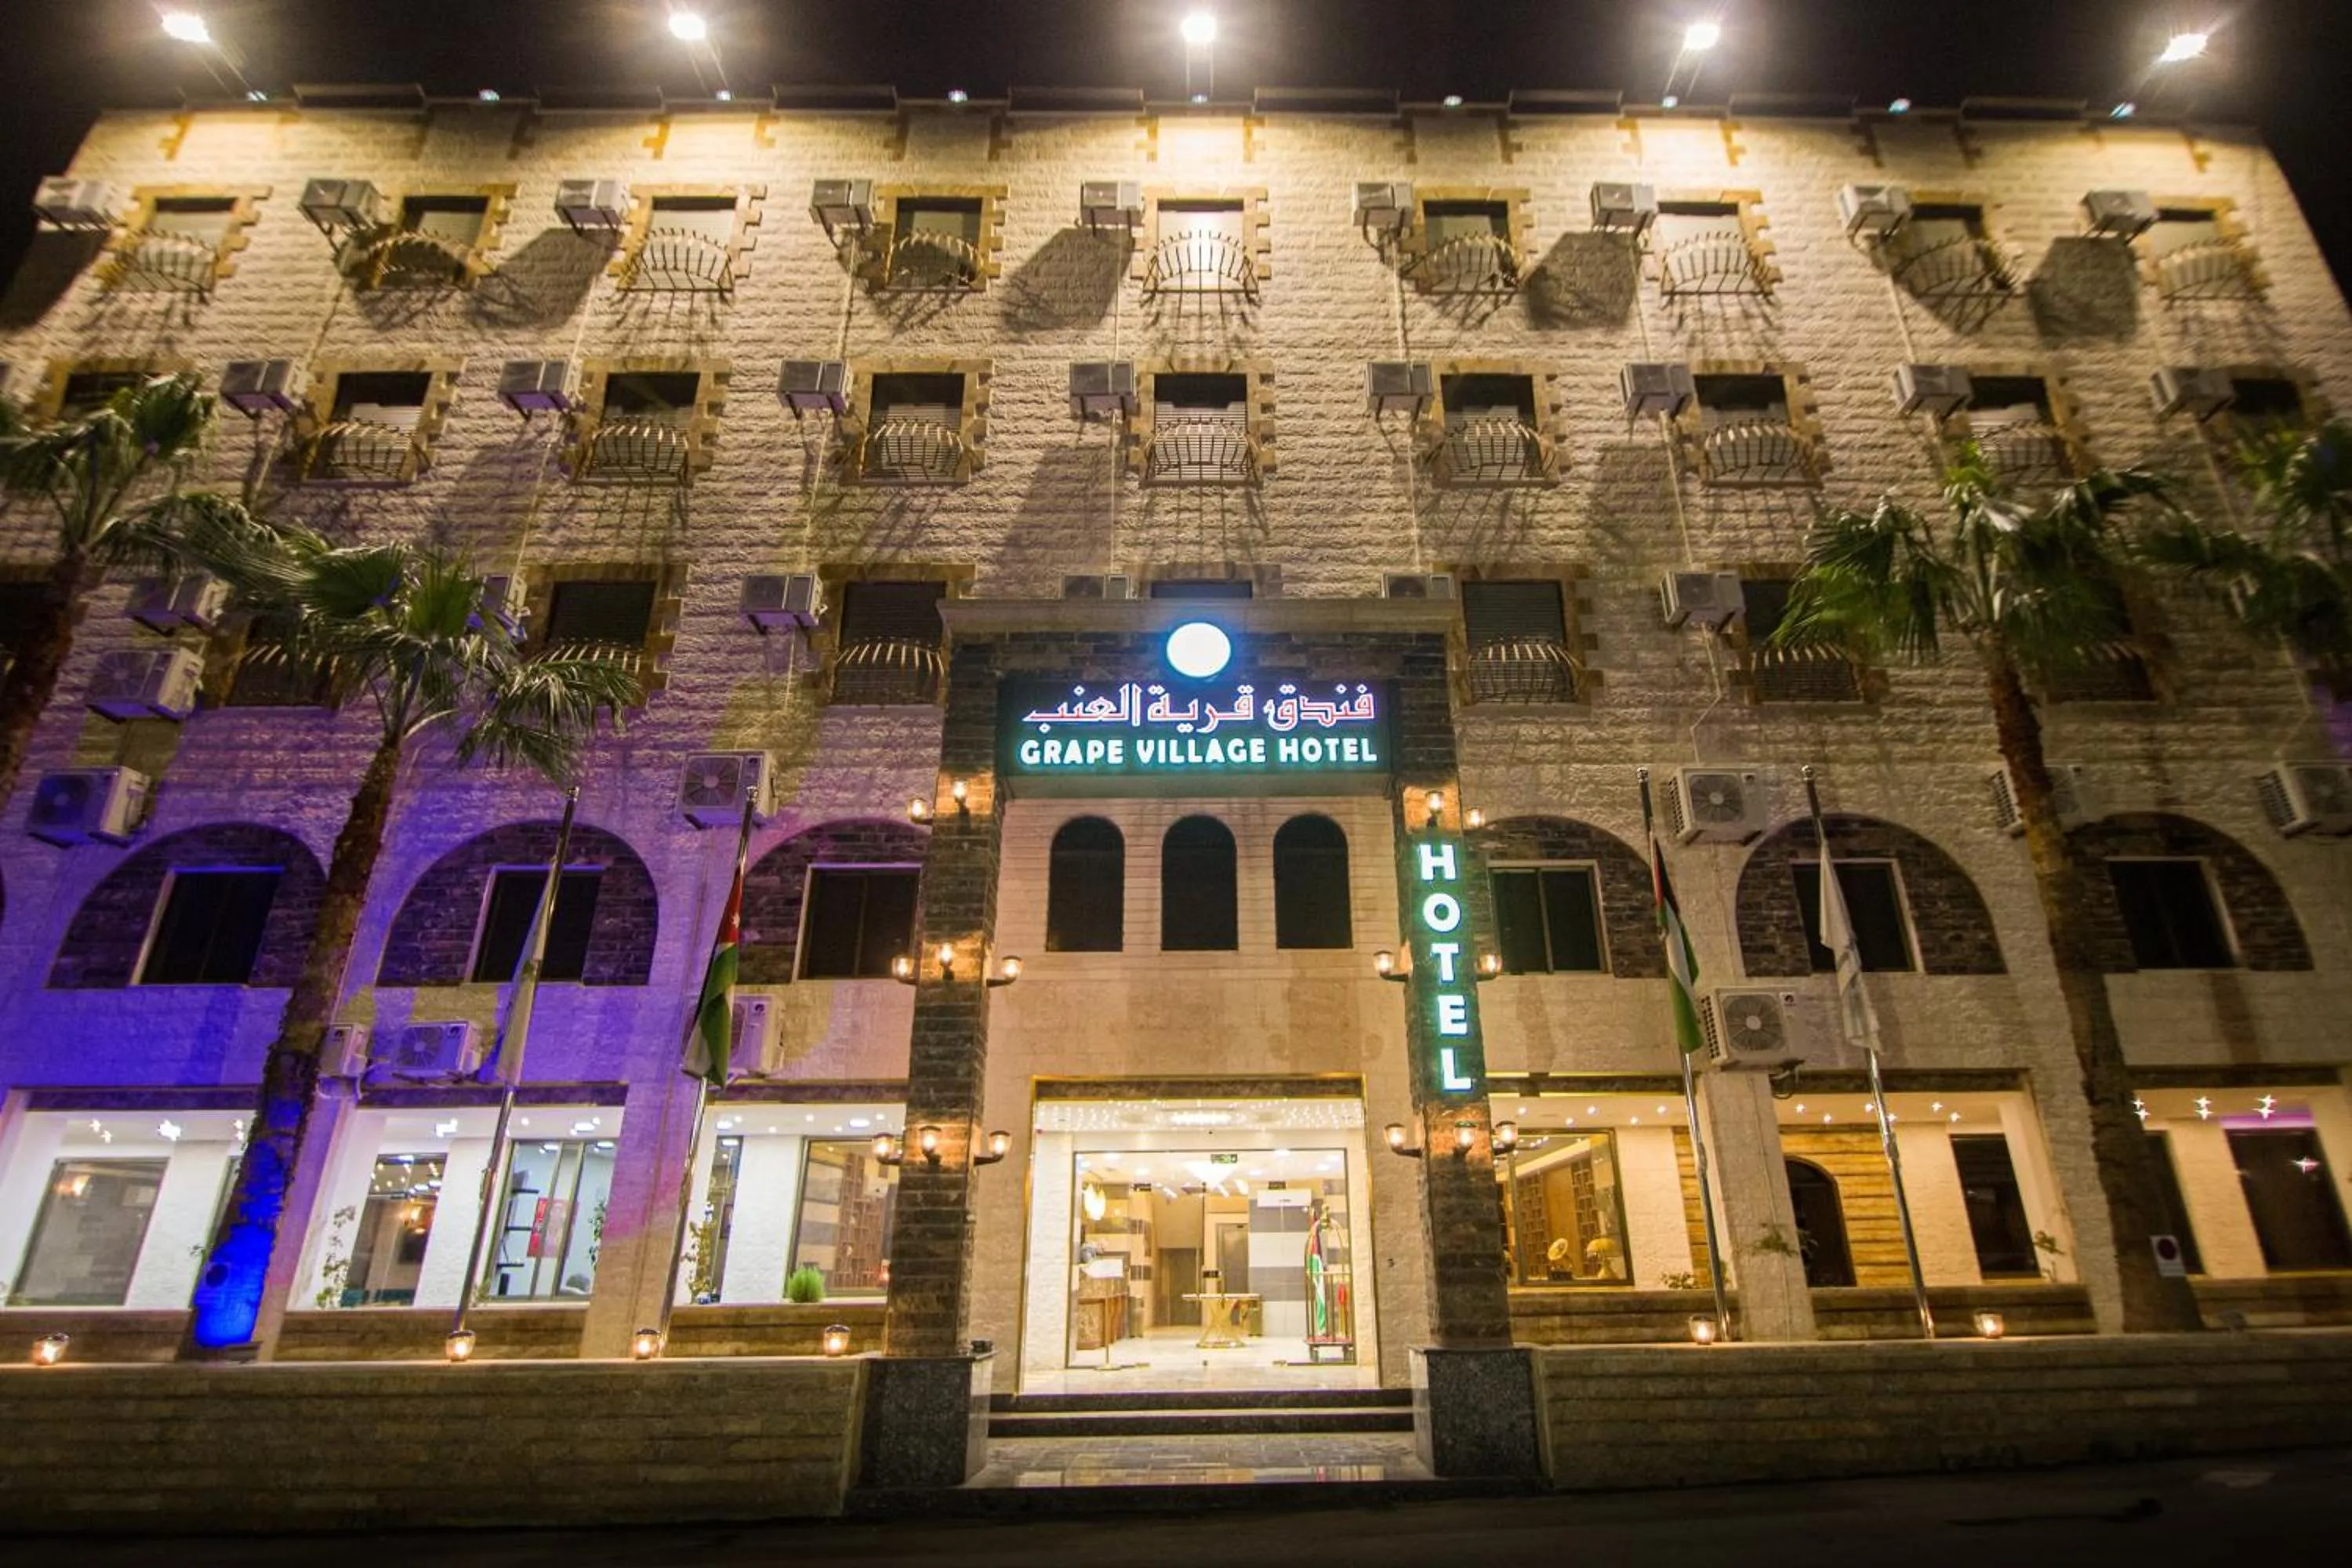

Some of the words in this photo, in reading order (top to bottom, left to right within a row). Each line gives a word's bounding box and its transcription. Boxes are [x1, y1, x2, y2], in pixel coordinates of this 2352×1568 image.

[1022, 683, 1142, 733] العنب
[1147, 684, 1254, 733] قرية
[1263, 683, 1374, 731] فندق
[1020, 739, 1123, 764] GRAPE
[1136, 738, 1266, 764] VILLAGE
[1279, 737, 1377, 763] HOTEL
[1419, 844, 1472, 1091] HOTEL
